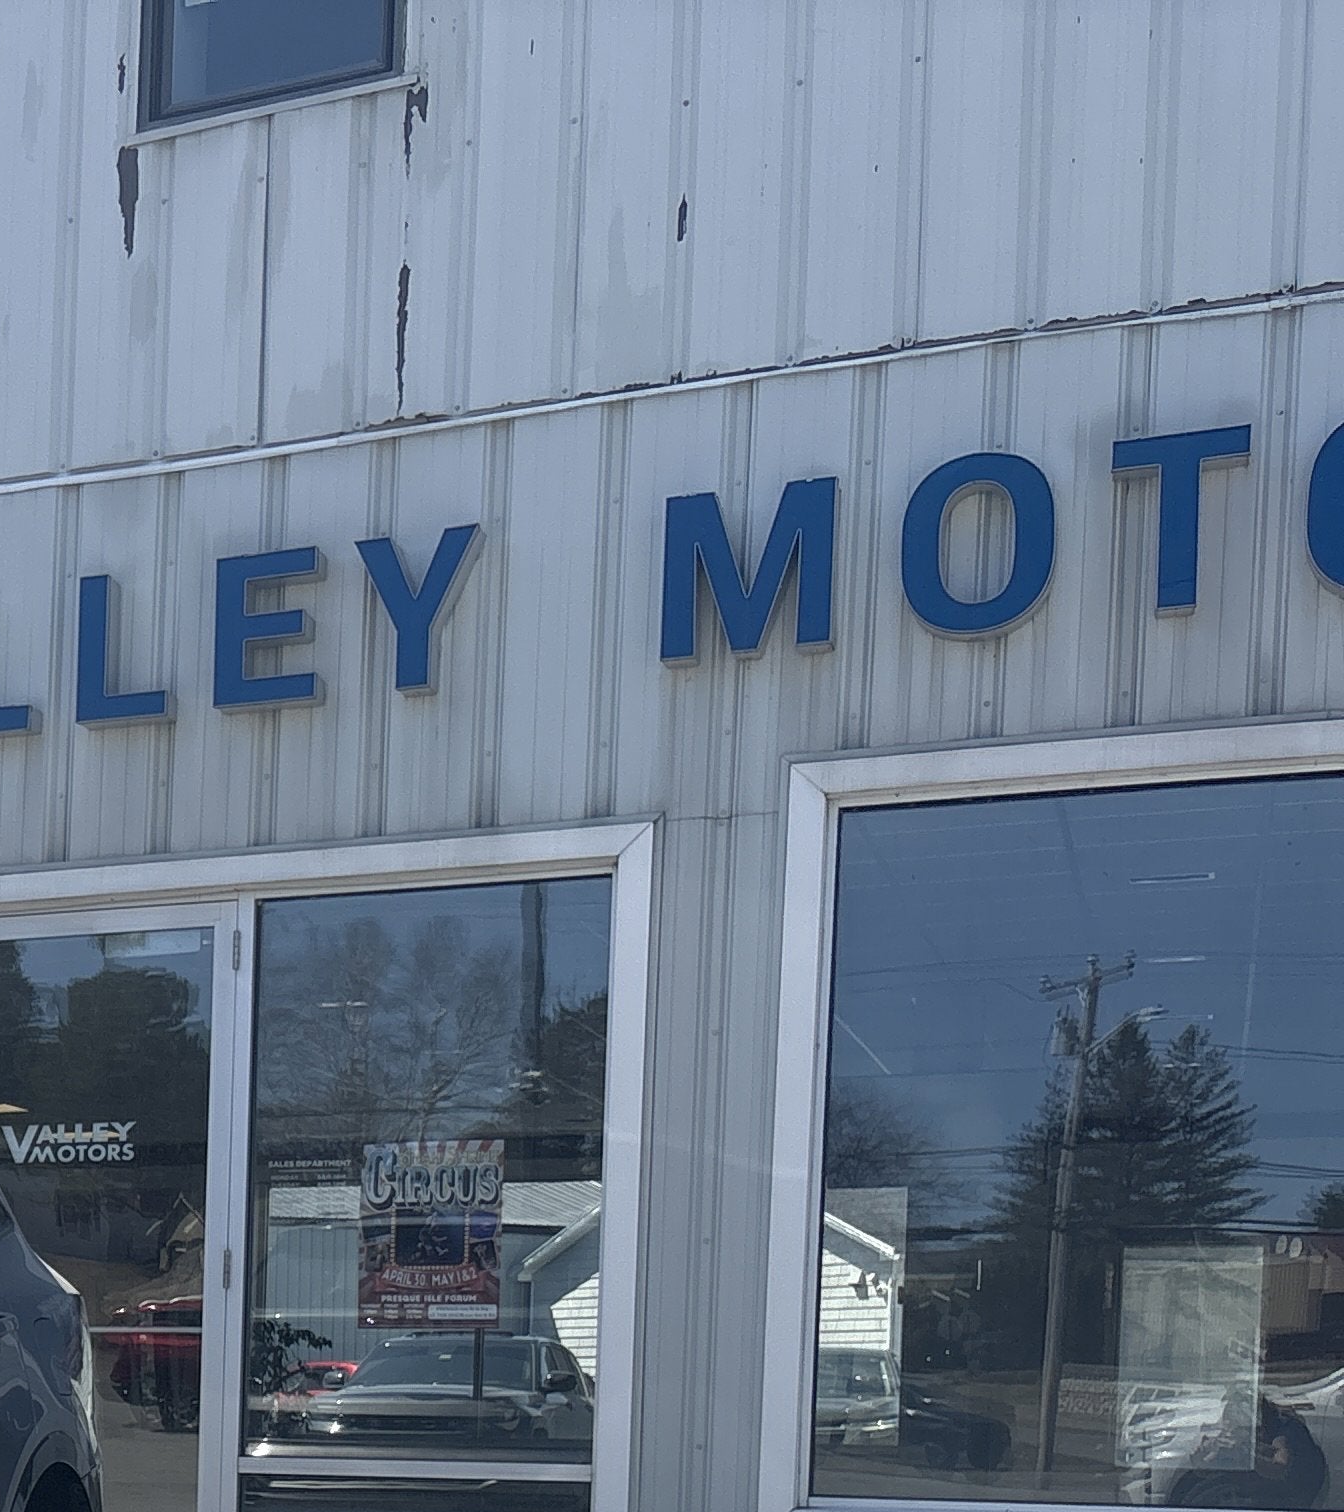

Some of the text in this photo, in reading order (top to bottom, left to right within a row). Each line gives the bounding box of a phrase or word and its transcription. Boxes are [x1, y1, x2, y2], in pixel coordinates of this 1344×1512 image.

[660, 421, 1344, 666] MOT
[1, 1121, 137, 1164] VALLEY
[27, 1143, 135, 1164] MOTORS
[268, 1159, 352, 1168] SALES DEPARTMENT
[365, 1150, 501, 1208] CIRCUS
[381, 1268, 412, 1285] APRIL
[431, 1272, 454, 1286] MAY
